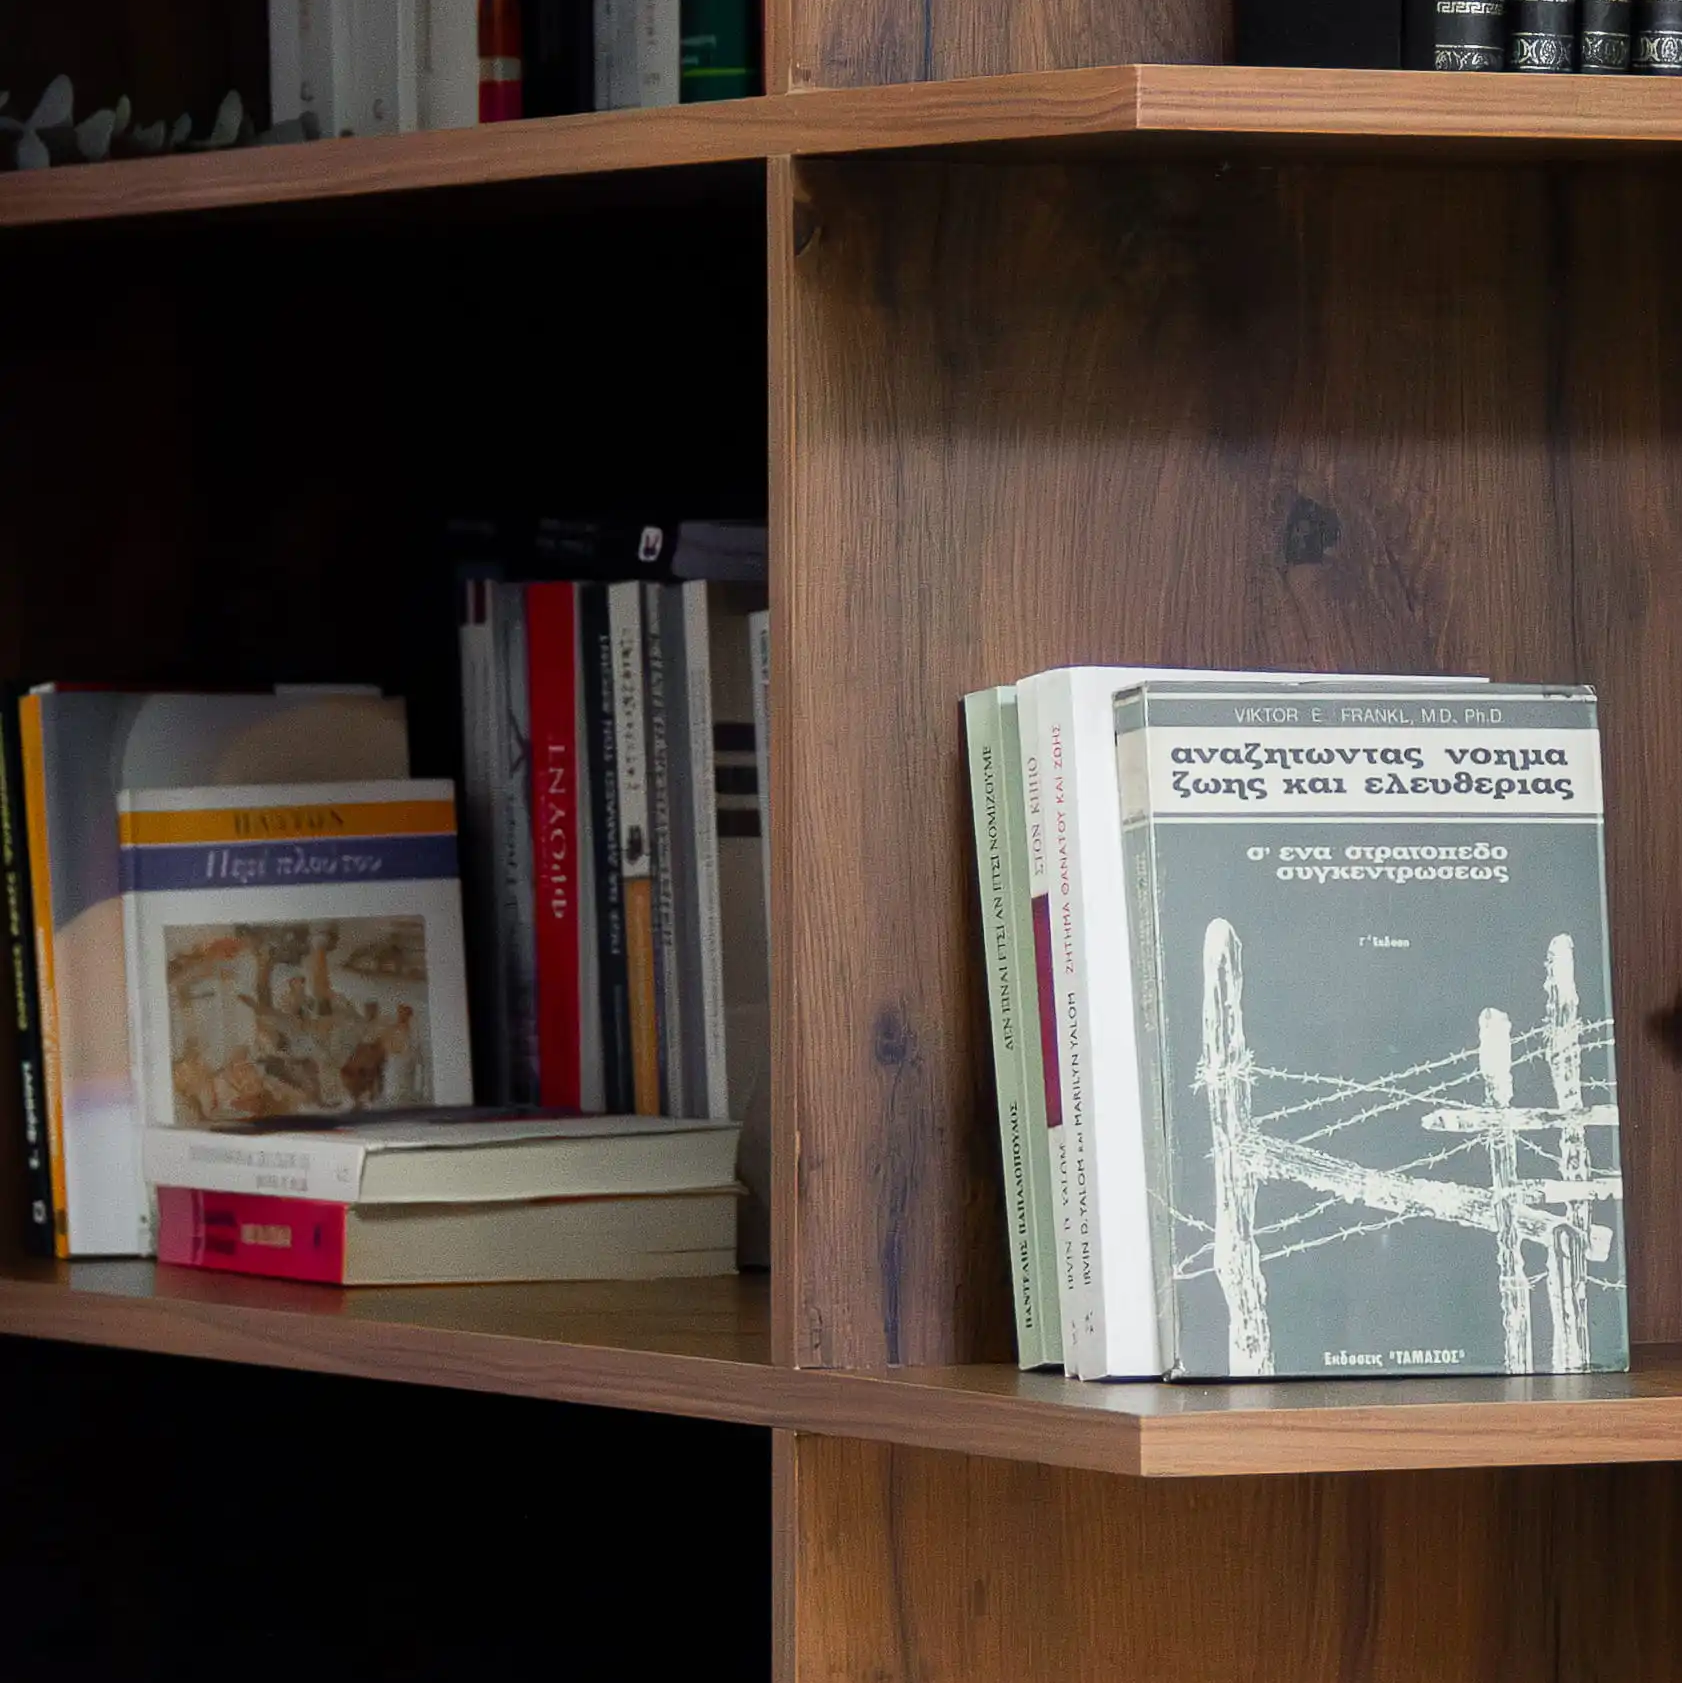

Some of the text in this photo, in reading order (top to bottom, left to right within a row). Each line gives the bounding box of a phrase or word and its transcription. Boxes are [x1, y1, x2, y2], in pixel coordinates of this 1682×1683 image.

[1234, 707, 1298, 723] VIKTOR
[1341, 708, 1415, 726] FRANKL,
[1170, 743, 1568, 771] αναζητωντας νοημα
[981, 746, 1000, 850] ΝΟΜΙΖΟΥΜΕ
[1172, 771, 1575, 801] ζωης και ελευθεριας
[1031, 822, 1045, 876] ΣΤΟΝ
[1051, 724, 1074, 974] ΖΗΤΗΜΑ ΘΑΝΑΤΟΥ ΚΑΙ ΖΩΗΣ
[1279, 846, 1332, 861] ενα
[1345, 843, 1508, 866] στρατοπεδο
[1276, 864, 1509, 884] συγκεντρωσεως
[1067, 991, 1078, 1050] YALOM
[1071, 1053, 1082, 1121] MARILYN
[1009, 1101, 1026, 1235] ΠΑΠΑΔΟΠΟΥΛΟΣ
[1081, 1241, 1092, 1286] IRVIN
